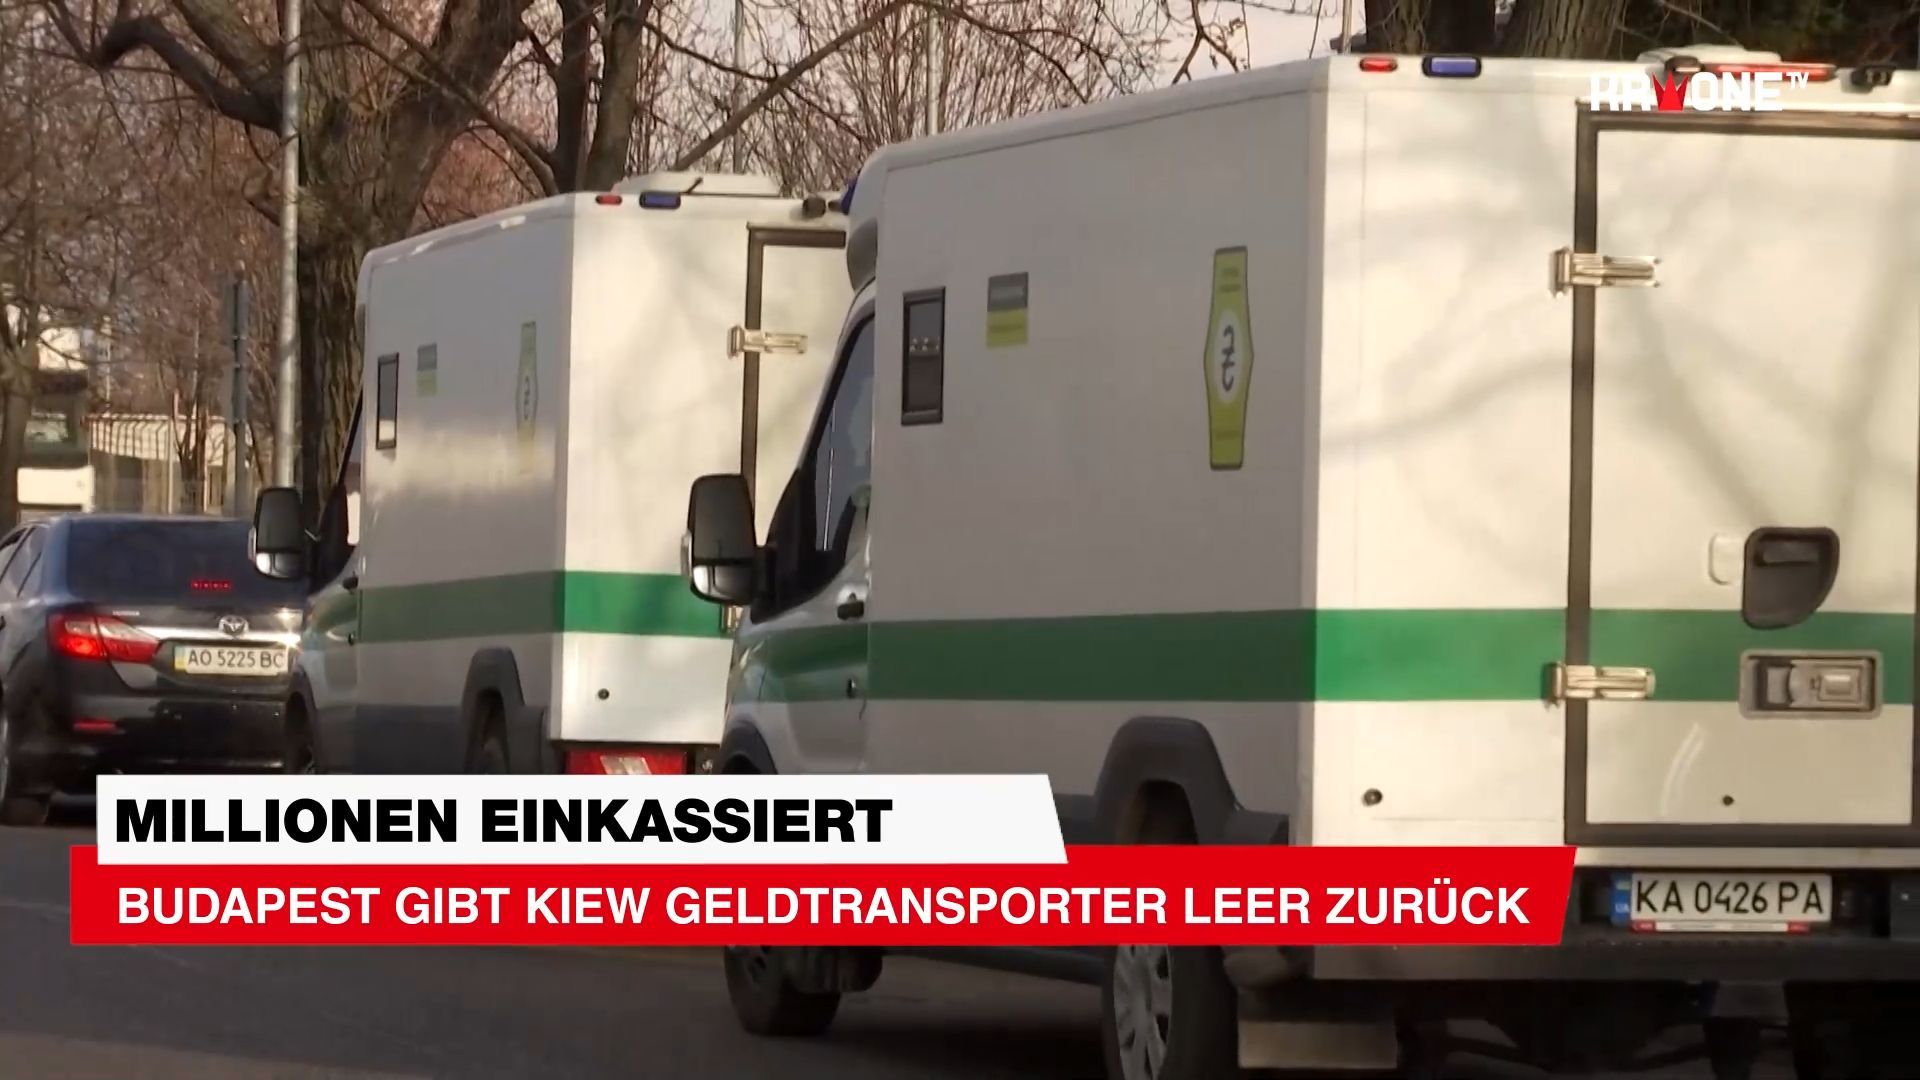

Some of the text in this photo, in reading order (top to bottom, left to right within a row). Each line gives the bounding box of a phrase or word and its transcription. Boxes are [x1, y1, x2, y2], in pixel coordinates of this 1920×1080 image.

[188, 650, 284, 668] AO 5225 BC
[1636, 880, 1823, 914] KA 0426 PA
